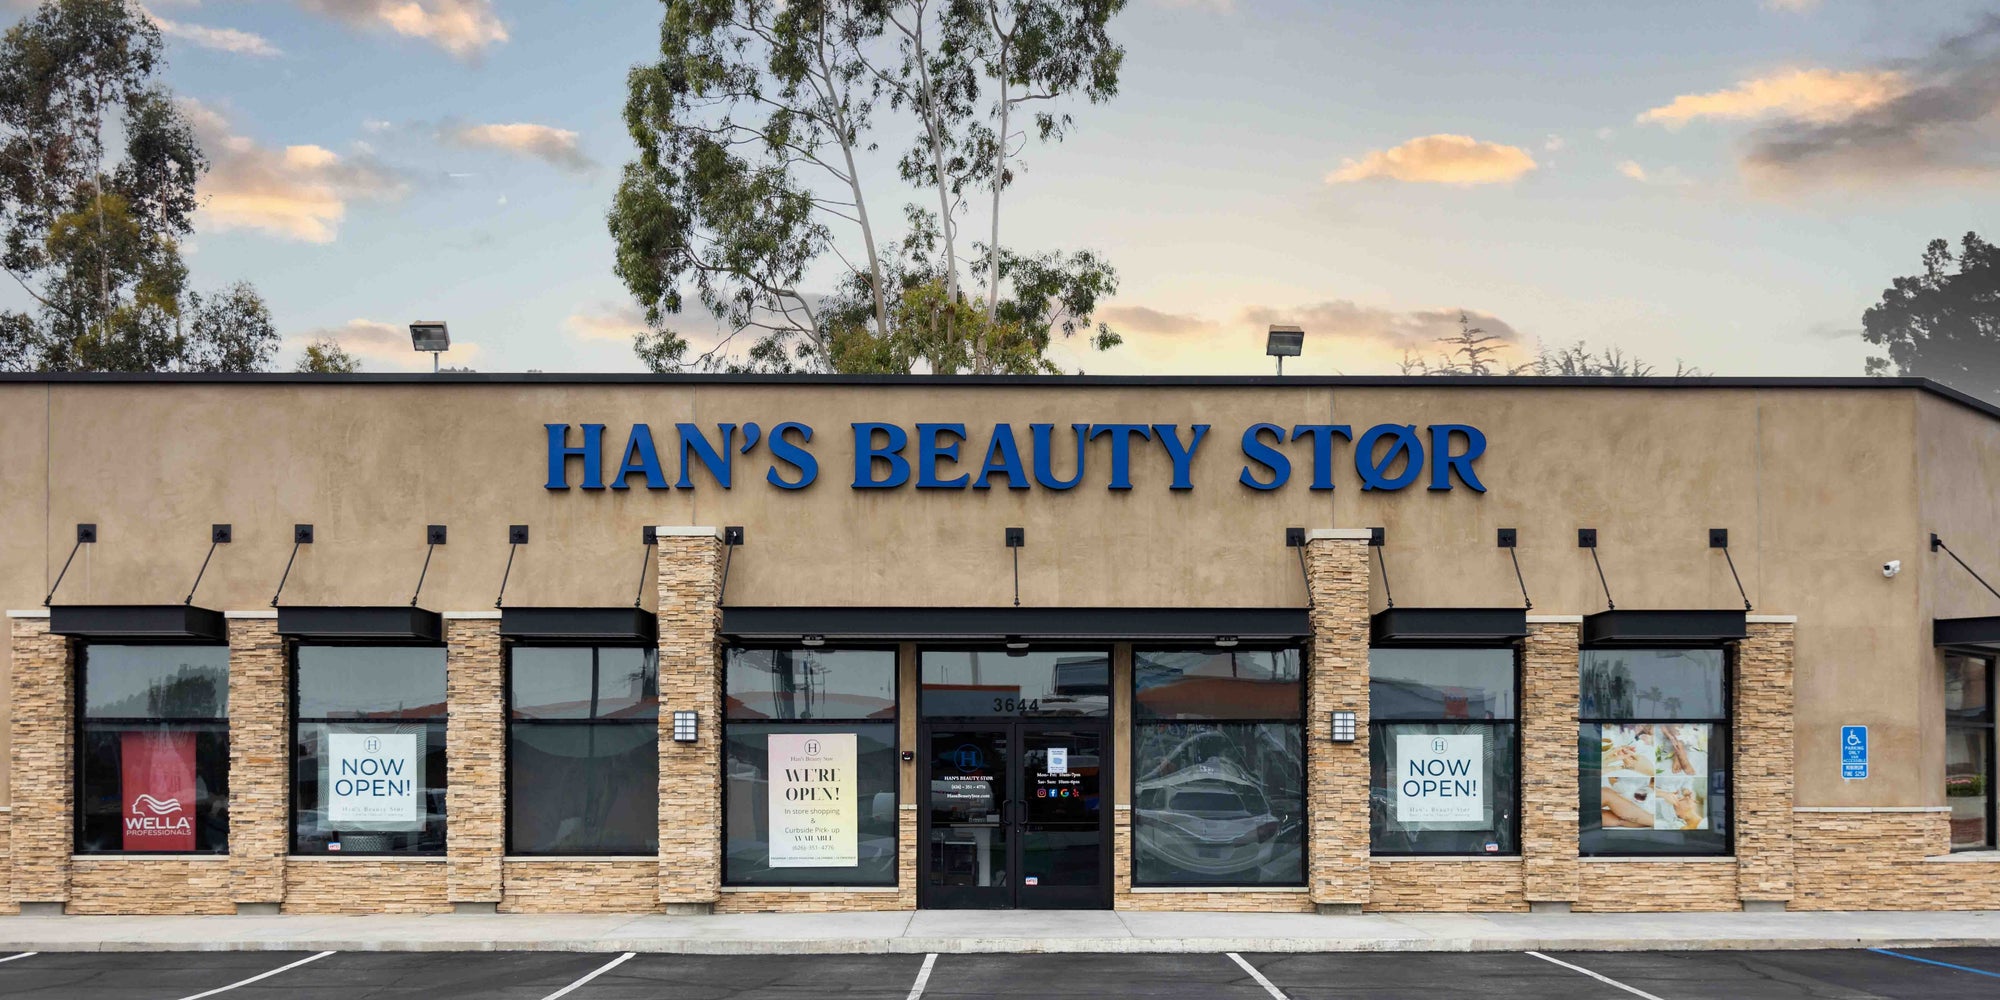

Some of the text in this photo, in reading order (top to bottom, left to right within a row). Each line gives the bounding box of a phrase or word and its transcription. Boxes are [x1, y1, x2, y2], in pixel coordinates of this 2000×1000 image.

[544, 422, 1487, 493] HAN'S BEAUTY STØR
[993, 698, 1039, 712] 3644
[342, 758, 404, 776] NOW
[1409, 759, 1471, 776] NOW
[785, 768, 841, 782] WE'RE
[335, 779, 410, 796] OPEN!
[785, 787, 840, 801] OPEN!
[1403, 780, 1476, 797] OPEN!
[810, 808, 840, 816] shopping
[125, 817, 190, 830] WELLA
